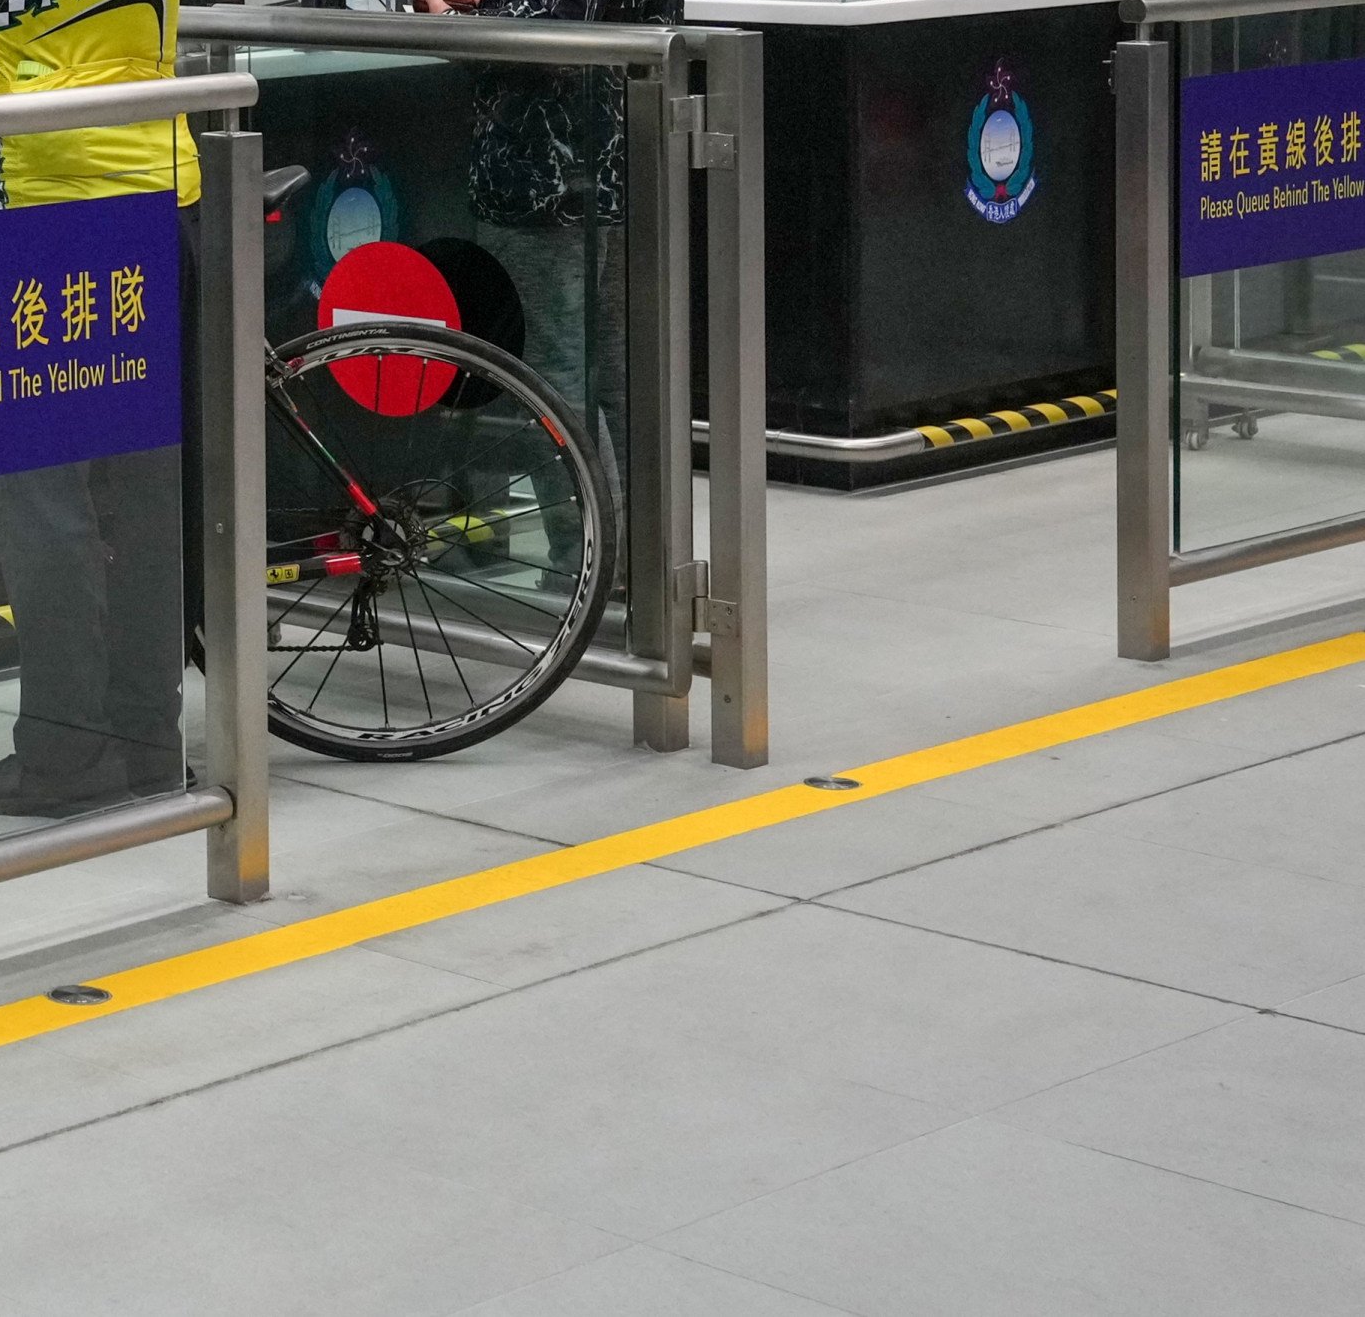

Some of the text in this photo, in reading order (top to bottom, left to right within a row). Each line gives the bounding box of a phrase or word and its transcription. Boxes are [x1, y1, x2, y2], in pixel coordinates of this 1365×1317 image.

[1200, 111, 1362, 182] 請在黃線後排
[1200, 175, 1365, 220] Please Queue Behind The Yellow
[305, 327, 391, 350] CONTINENTAL
[9, 367, 43, 400] The
[48, 357, 105, 394] Yellow
[112, 353, 148, 384] Line
